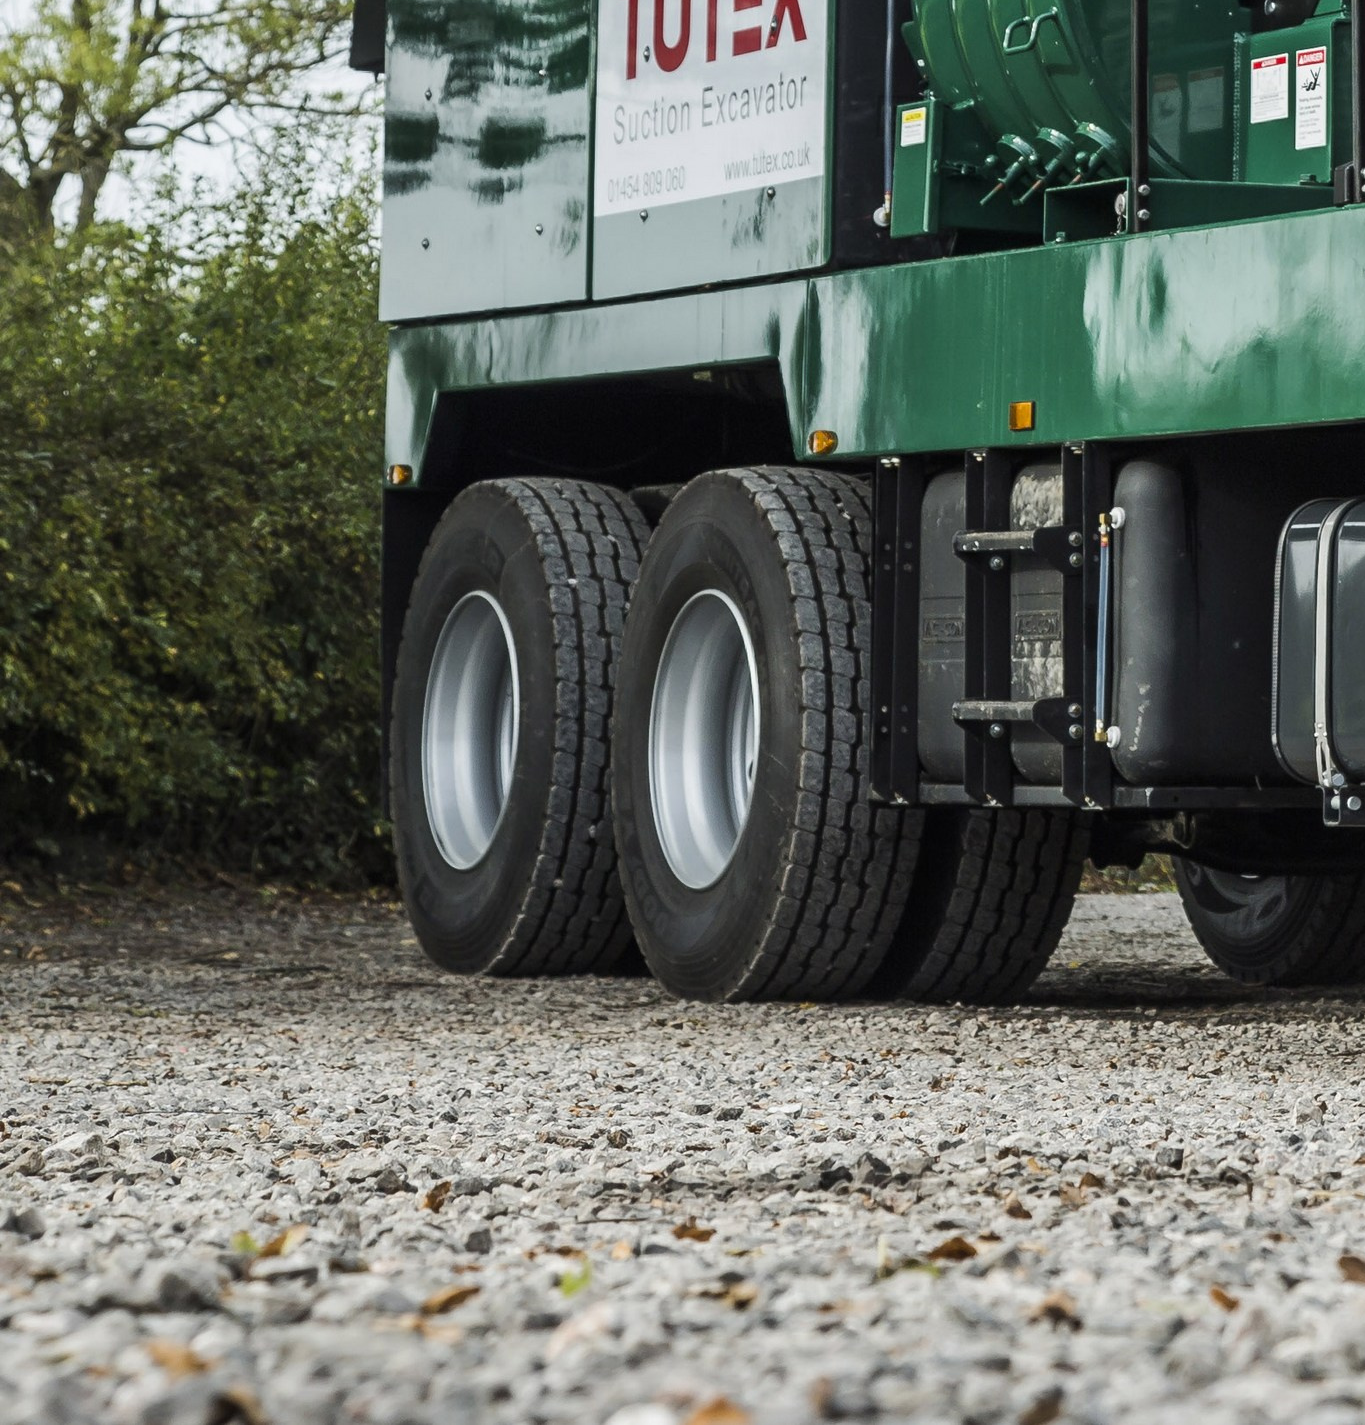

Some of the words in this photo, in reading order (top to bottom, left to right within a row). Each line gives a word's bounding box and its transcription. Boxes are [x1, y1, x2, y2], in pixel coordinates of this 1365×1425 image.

[613, 97, 690, 145] Suction
[702, 72, 807, 127] Excavator
[723, 141, 810, 181] www.tutex.co.uk
[607, 176, 640, 203] 01454
[643, 170, 663, 196] 809
[665, 165, 686, 192] 060
